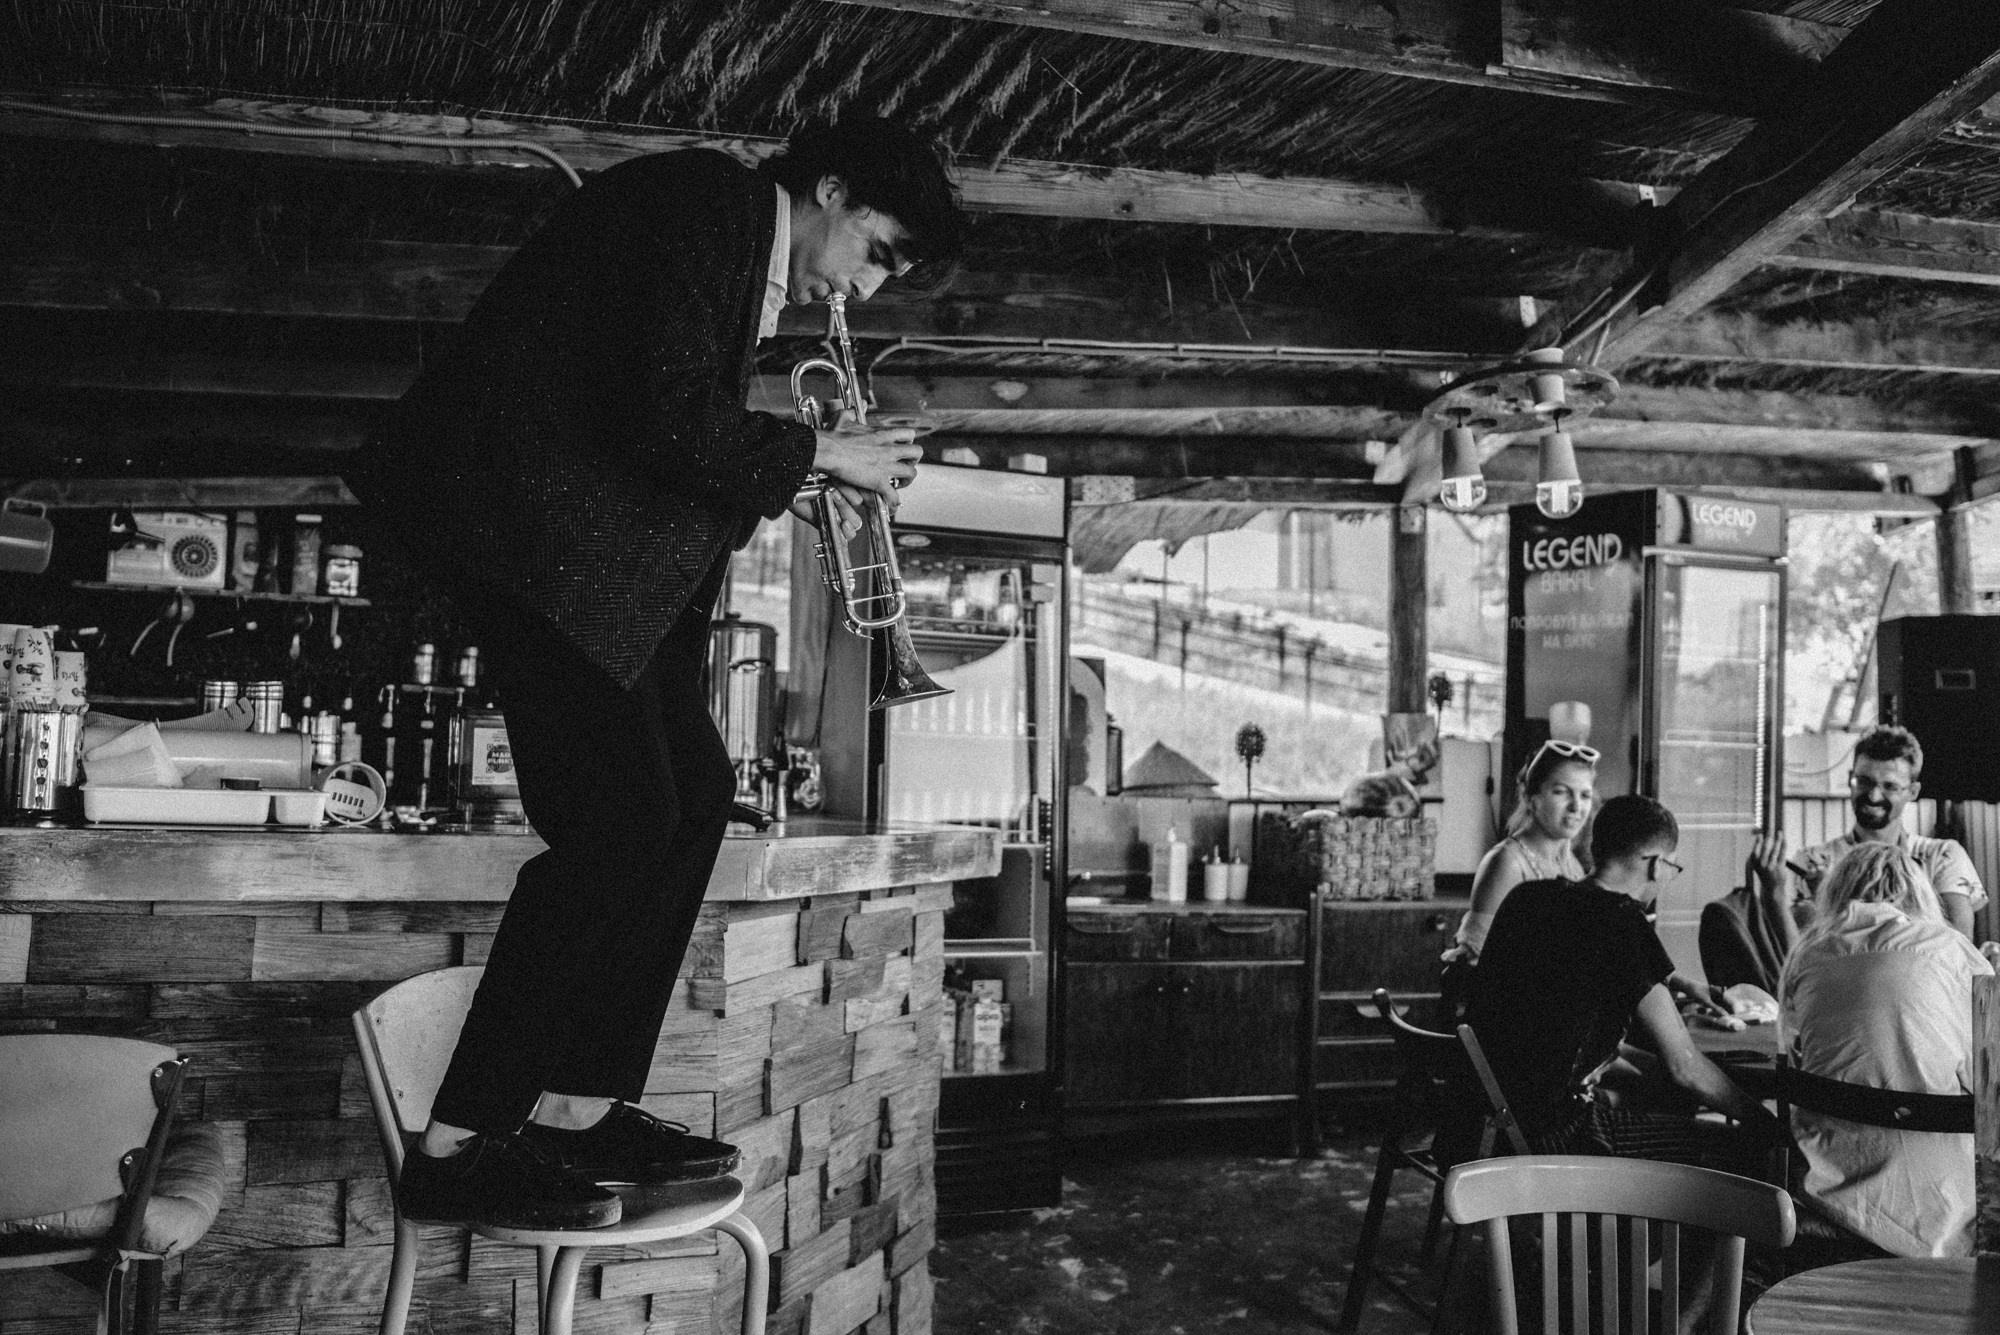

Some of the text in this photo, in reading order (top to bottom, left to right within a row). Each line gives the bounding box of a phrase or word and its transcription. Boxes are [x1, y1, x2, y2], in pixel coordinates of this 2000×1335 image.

[1692, 503, 1757, 529] LEGEND
[1523, 533, 1622, 571] LEGEND
[1541, 570, 1594, 594] BAIKAL
